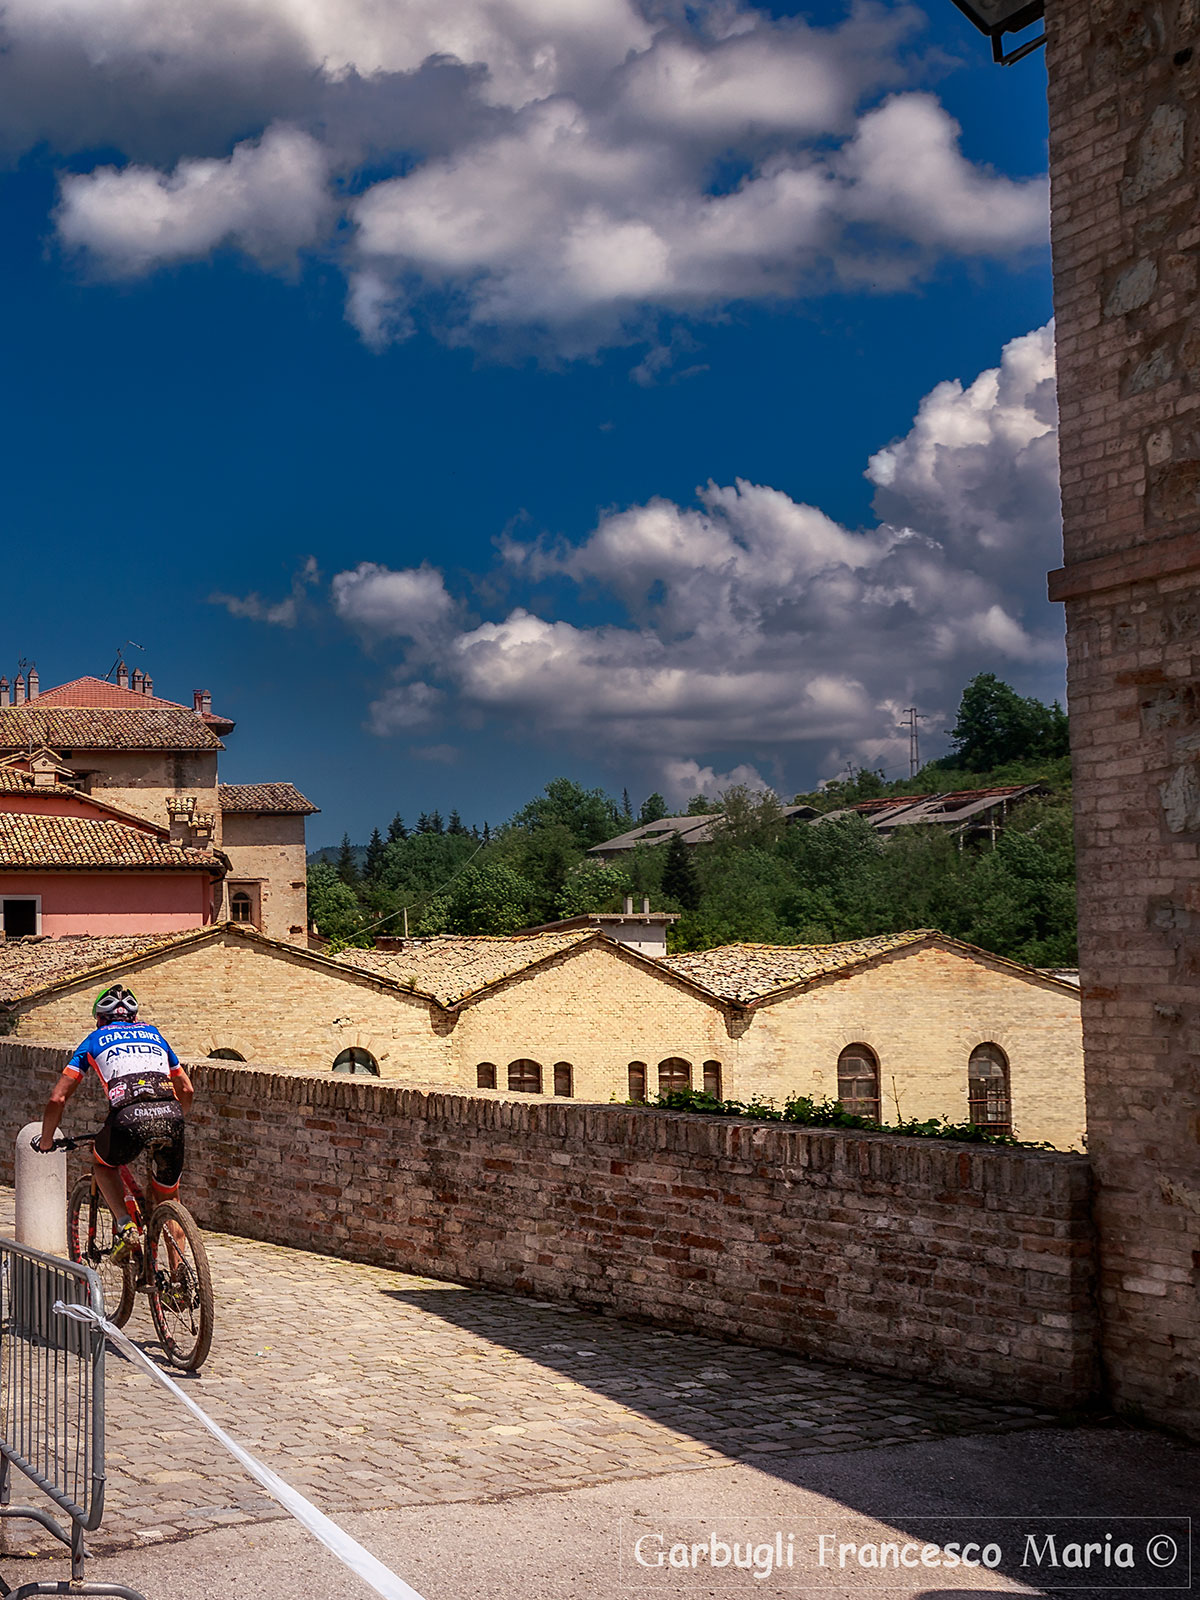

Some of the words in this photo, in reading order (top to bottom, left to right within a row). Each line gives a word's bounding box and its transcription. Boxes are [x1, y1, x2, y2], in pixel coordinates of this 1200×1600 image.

[98, 1030, 162, 1046] CRAZYBIKE
[106, 1045, 162, 1061] ANTOS
[134, 1105, 172, 1117] CRAZYBIKE
